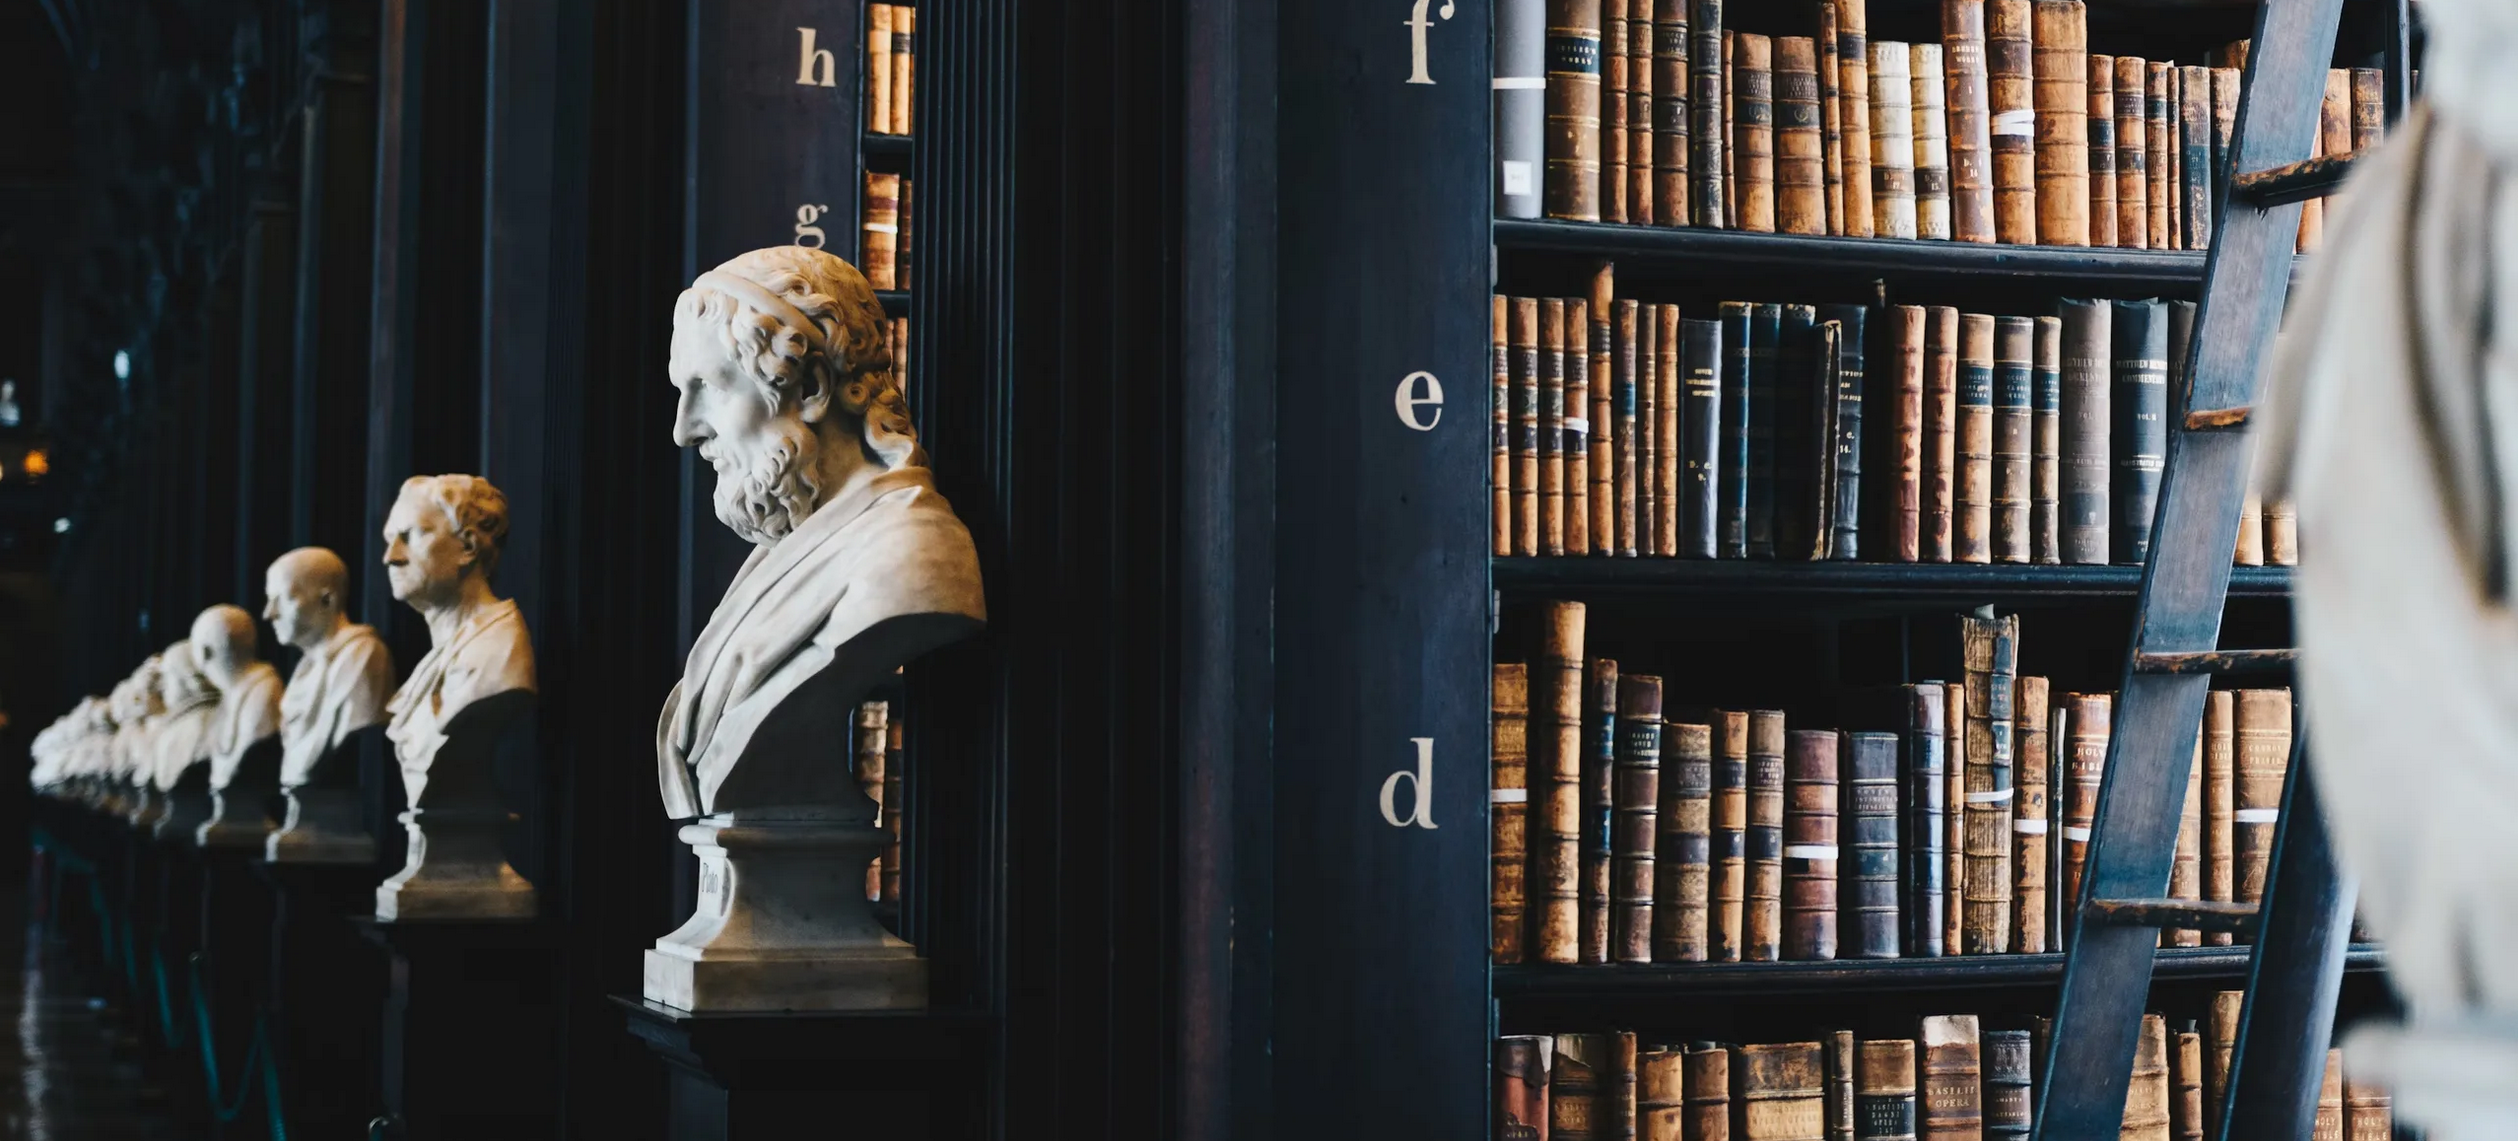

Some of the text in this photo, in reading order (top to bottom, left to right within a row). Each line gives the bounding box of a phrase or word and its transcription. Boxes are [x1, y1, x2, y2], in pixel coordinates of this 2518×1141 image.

[795, 26, 836, 87] h
[1403, 0, 1455, 85] f
[794, 204, 829, 250] g
[1395, 370, 1444, 431] e
[1380, 737, 1439, 829] d
[2071, 761, 2101, 772] BIBL
[1935, 1099, 1970, 1109] OPERA
